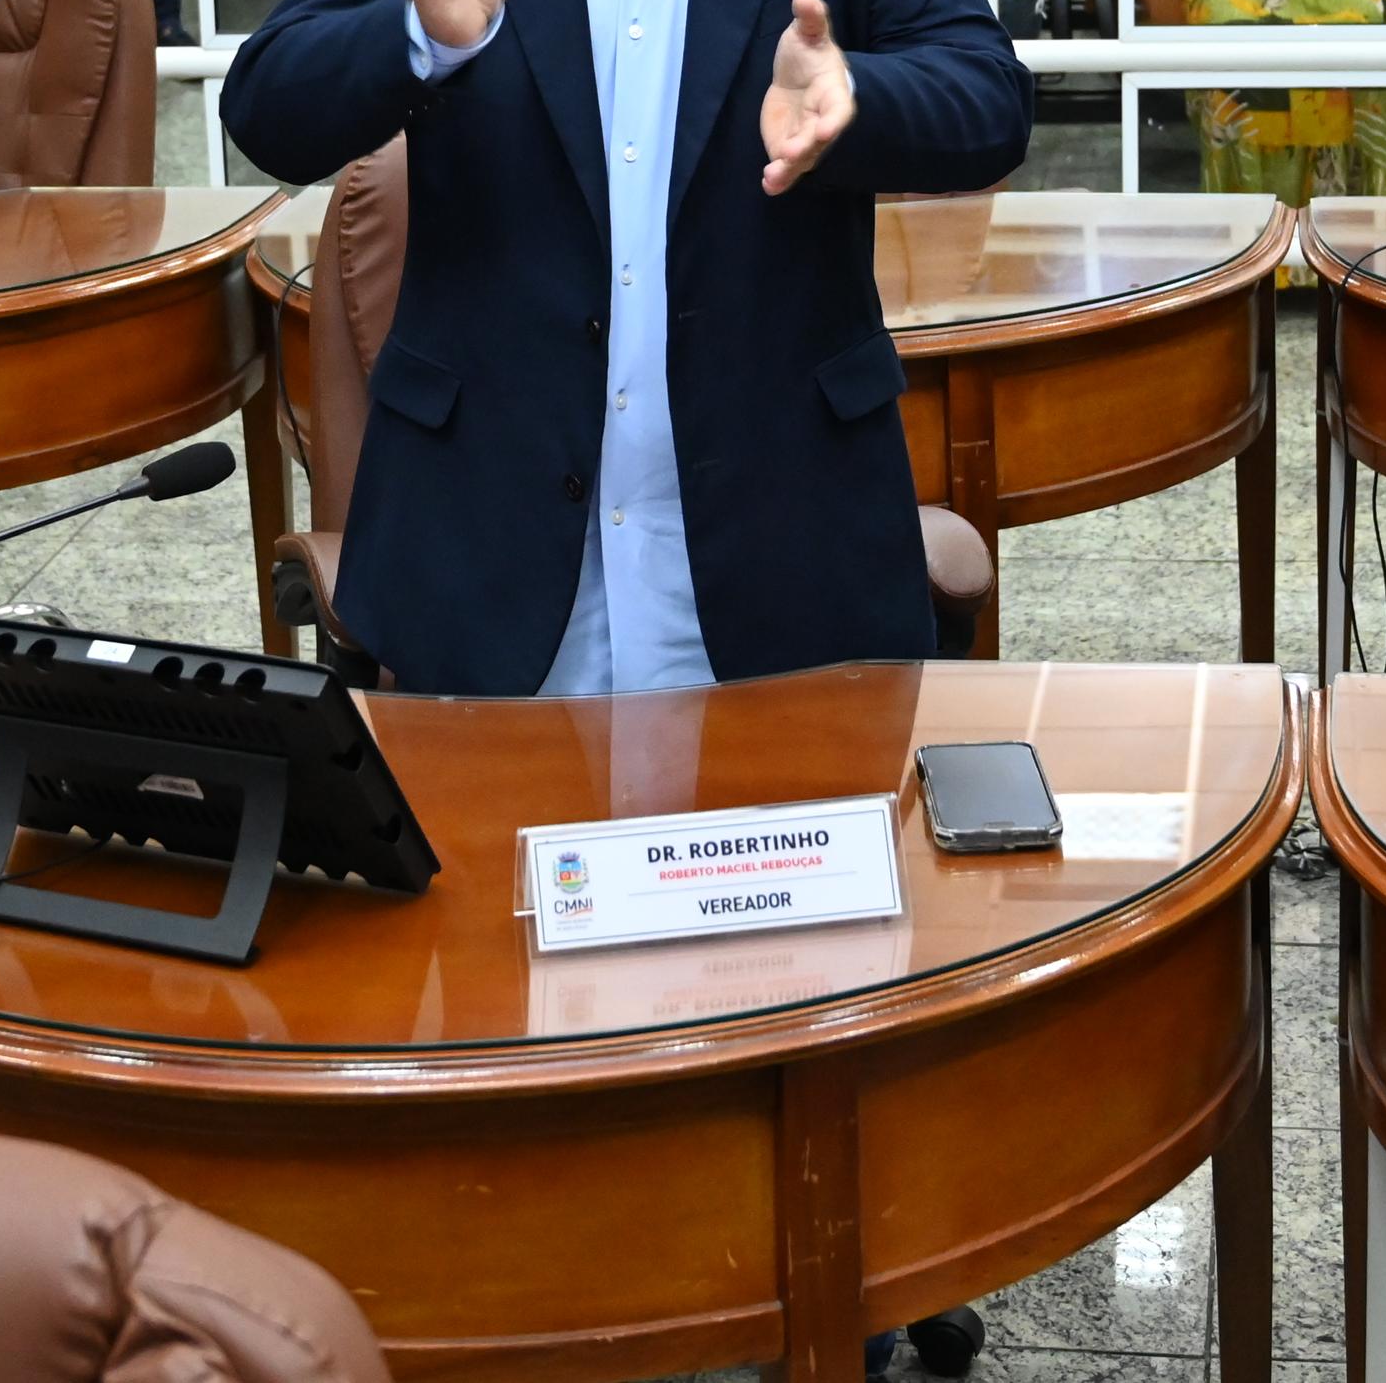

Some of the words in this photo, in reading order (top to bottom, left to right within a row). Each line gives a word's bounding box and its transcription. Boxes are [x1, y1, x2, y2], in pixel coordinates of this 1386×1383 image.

[647, 845, 683, 863] DR.
[689, 830, 830, 859] ROBERTINHO
[659, 866, 714, 880] ROBERTO
[716, 862, 759, 875] MACIEL
[761, 855, 823, 870] REBOUÇAS
[554, 897, 593, 914] CMNI
[698, 891, 792, 915] VEREADOR
